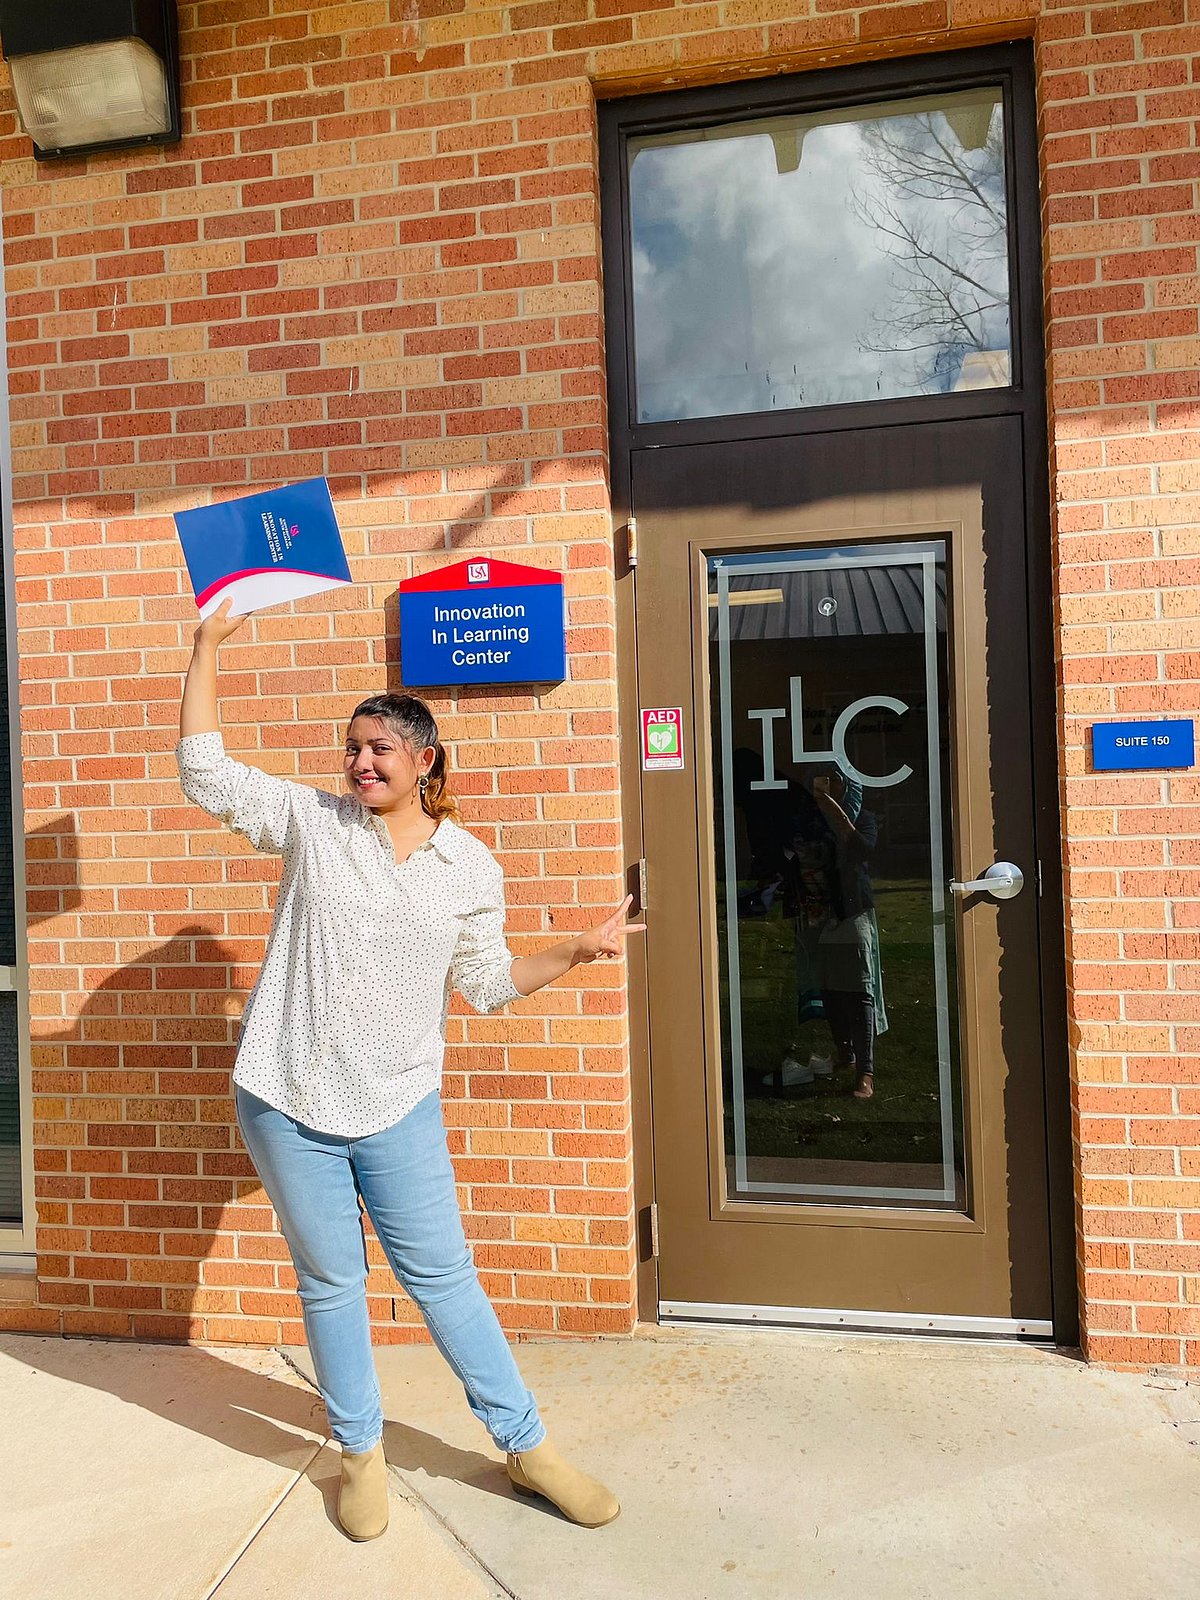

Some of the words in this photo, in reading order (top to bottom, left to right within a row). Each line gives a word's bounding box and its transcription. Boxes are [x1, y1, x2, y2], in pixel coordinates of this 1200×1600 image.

[261, 513, 272, 541] LEARNING
[268, 540, 278, 563] CENTER
[267, 512, 281, 552] INNOVATION
[278, 553, 284, 561] IN
[470, 565, 487, 579] USA
[434, 603, 525, 622] Innovation
[432, 629, 448, 645] In
[453, 625, 530, 644] Learning
[452, 649, 511, 666] Center
[647, 710, 677, 723] AED
[747, 676, 914, 790] ILC
[1115, 737, 1148, 747] SUITE
[1151, 736, 1170, 745] 150
